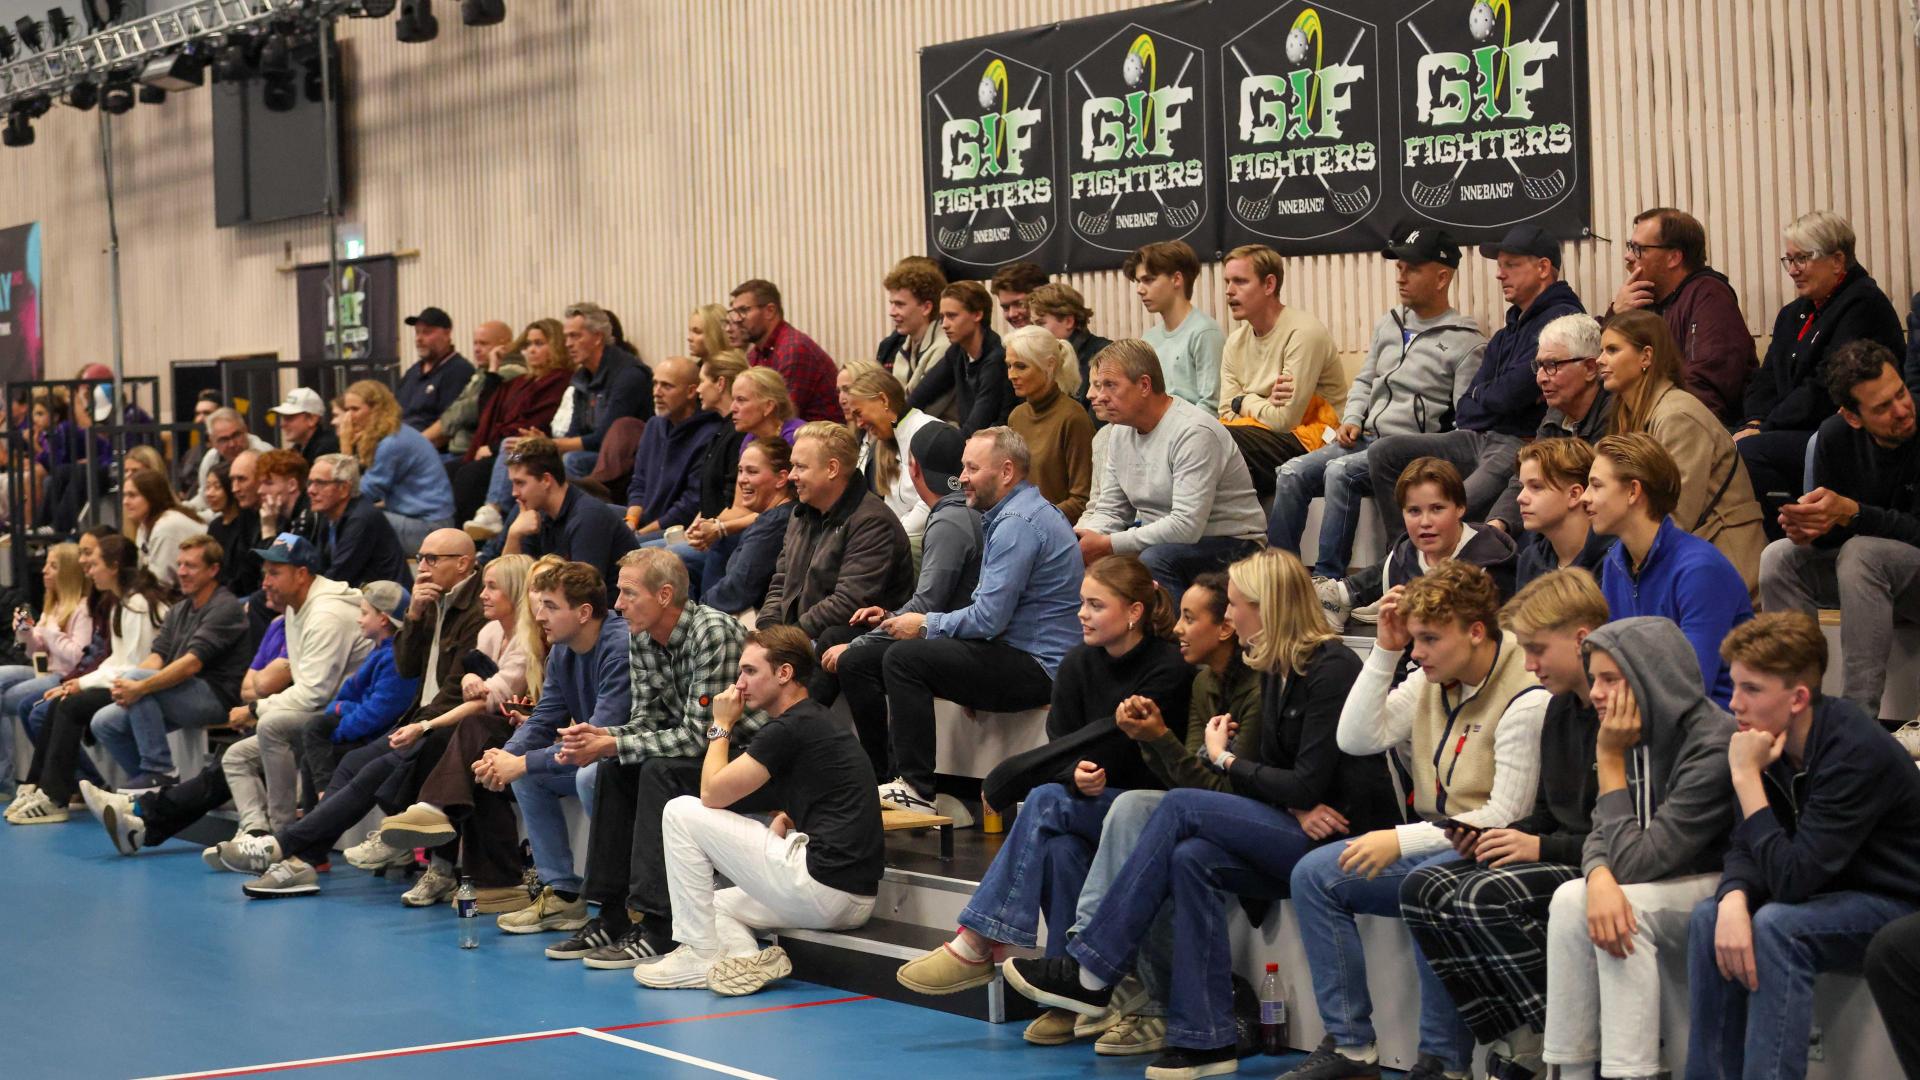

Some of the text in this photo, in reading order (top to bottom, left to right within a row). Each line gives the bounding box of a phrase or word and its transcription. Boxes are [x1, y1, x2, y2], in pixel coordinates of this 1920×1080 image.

[1238, 62, 1365, 145] GIF
[1416, 39, 1559, 126] GIF
[940, 107, 1042, 181] GIF
[1081, 86, 1194, 163] GIF
[1403, 122, 1573, 167] FIGHTERS
[1070, 158, 1204, 200] FIGHTERS
[1228, 140, 1377, 184] FIGHTERS
[932, 176, 1053, 217] FIGHTERS
[1277, 197, 1325, 215] INNEBANDY
[1460, 181, 1514, 201] INNEBANDY
[973, 226, 1011, 244] INNEBANDY
[1115, 211, 1159, 229] INNEBANDY
